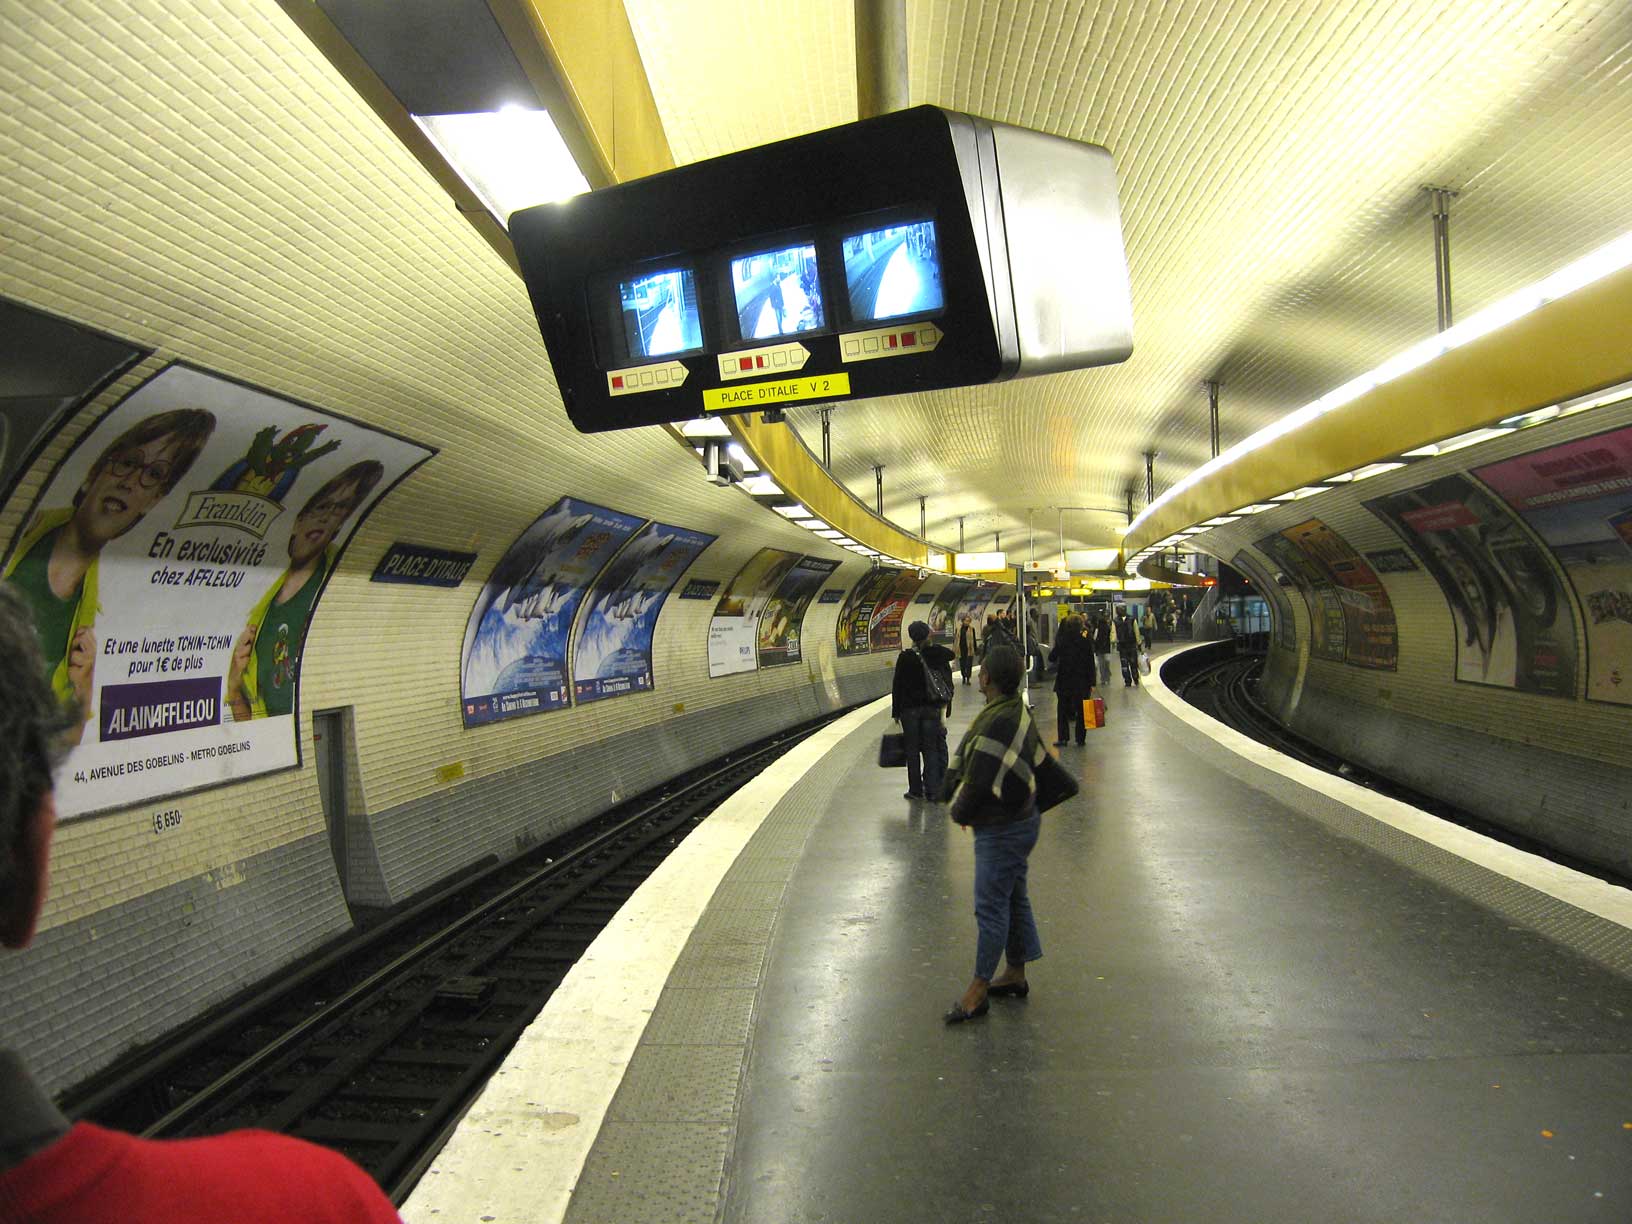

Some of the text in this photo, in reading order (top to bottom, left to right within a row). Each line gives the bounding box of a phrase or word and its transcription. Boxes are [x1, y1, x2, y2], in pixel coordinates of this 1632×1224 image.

[721, 380, 830, 403] PLACE D'ITALIE V 2
[194, 496, 267, 529] Franklin
[148, 531, 269, 567] En exclusivité
[151, 565, 246, 588] chez AFFLELOU
[383, 554, 430, 576] PLACE
[104, 634, 233, 655] Et une lunette TCHIN-TCHIN
[128, 655, 204, 677] pour 1€ de plus
[74, 769, 88, 784] 44,
[90, 762, 125, 781] AVENUE
[126, 759, 144, 774] DES
[145, 752, 185, 769] GOBELINS
[190, 746, 217, 761] METRO
[217, 740, 251, 757] GOBELINS
